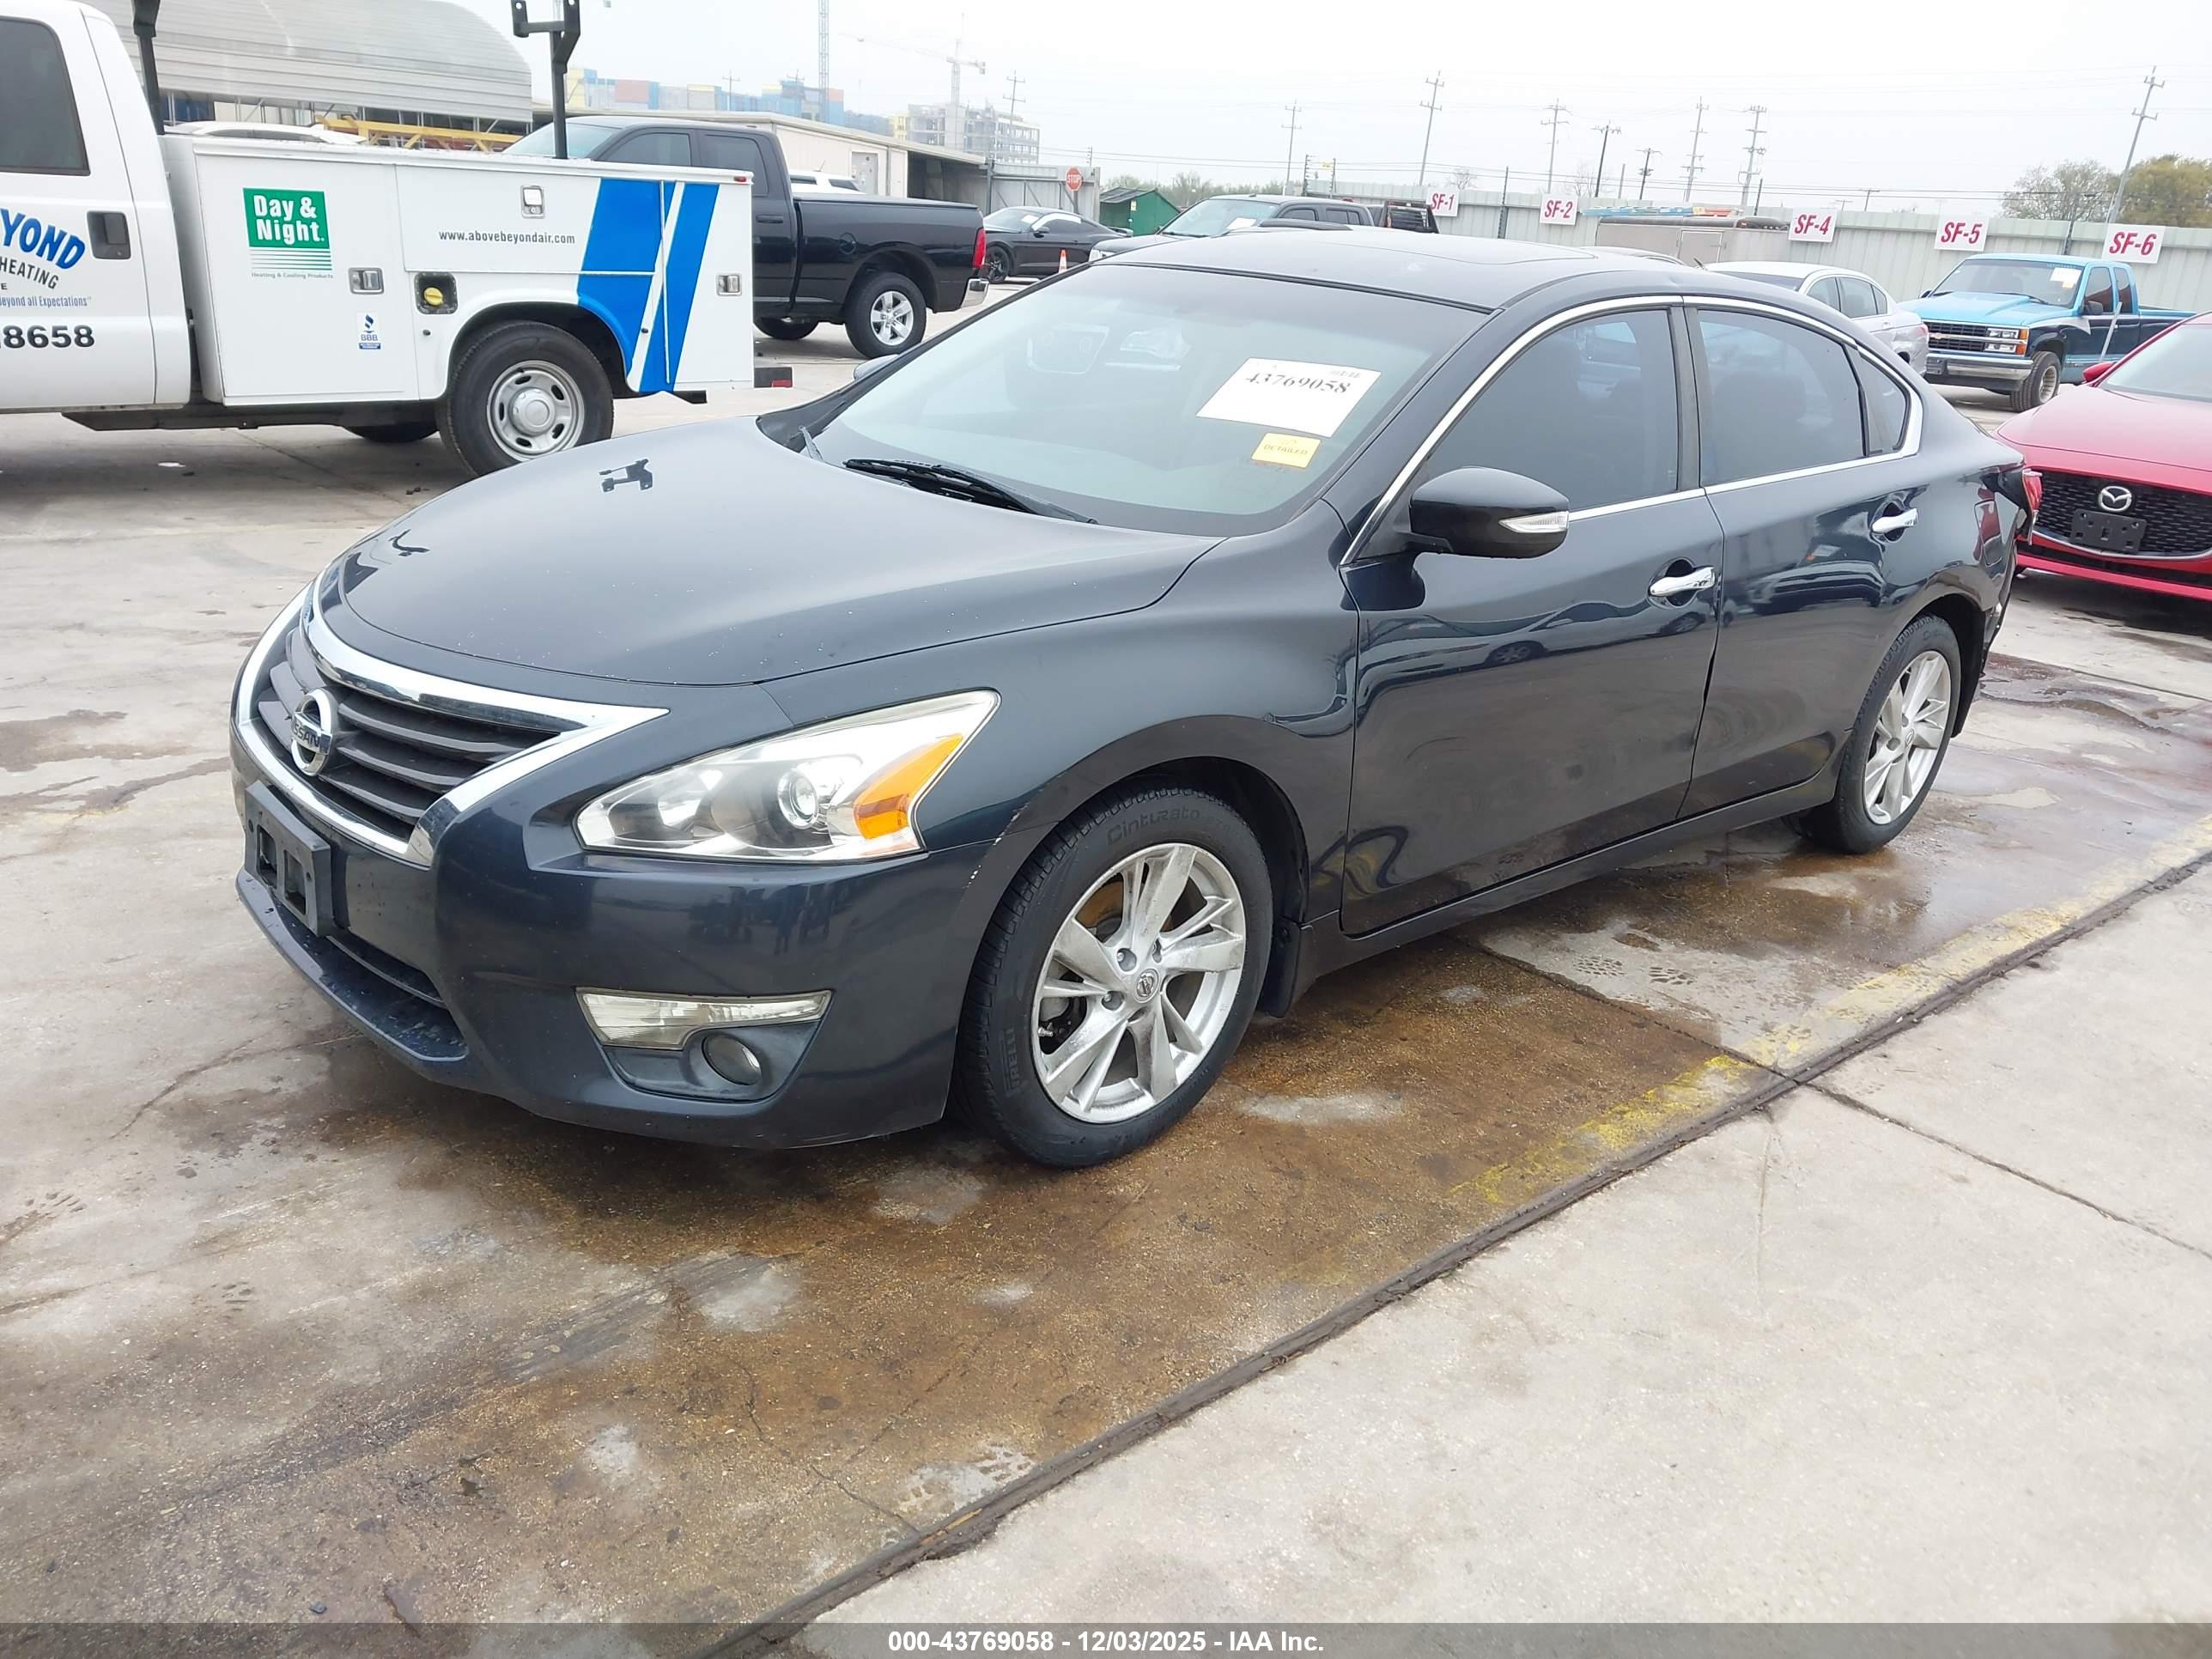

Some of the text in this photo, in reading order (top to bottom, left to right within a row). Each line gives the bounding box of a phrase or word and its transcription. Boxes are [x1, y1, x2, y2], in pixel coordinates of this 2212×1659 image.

[253, 195, 317, 222] Day &
[1431, 193, 1455, 210] SF-1
[1545, 199, 1573, 218] SF-2
[1794, 213, 1832, 235] SF-4
[1940, 221, 1980, 245] SF-5
[0, 208, 86, 270] YOND
[439, 230, 575, 245] www.abovebeyondair.com
[2108, 230, 2157, 256] SF-6
[0, 257, 59, 289] HEATING
[27, 295, 38, 307] all
[361, 333, 378, 342] BBB
[1245, 372, 1350, 393] 43769058
[294, 722, 320, 748] SSAN
